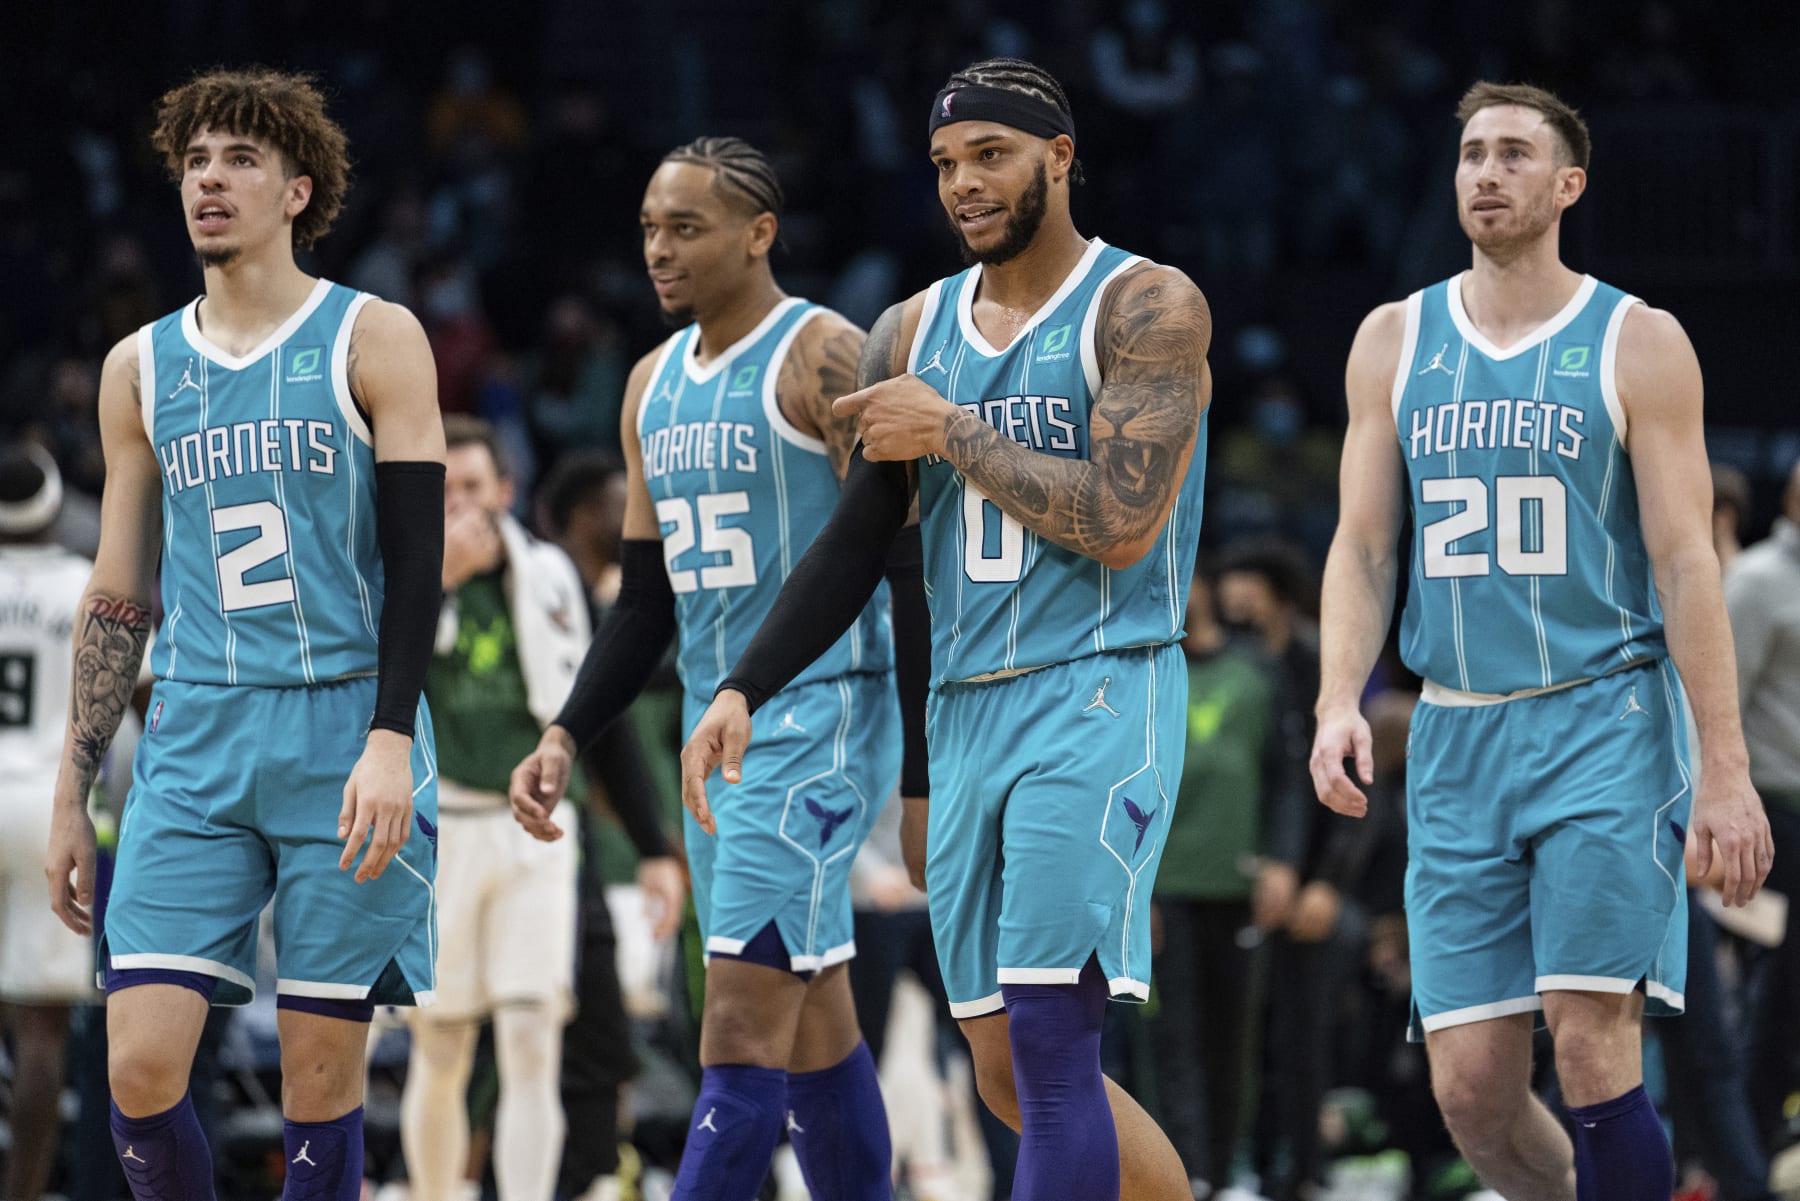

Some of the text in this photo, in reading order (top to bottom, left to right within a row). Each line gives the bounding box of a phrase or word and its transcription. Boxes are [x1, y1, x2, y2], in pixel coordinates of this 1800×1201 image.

[161, 418, 341, 496] HORNETS
[642, 421, 760, 480] HORNETS
[1407, 398, 1588, 461] HORNETS
[211, 500, 297, 612] 2
[656, 491, 758, 593] 25
[963, 474, 1025, 583] 0
[1421, 475, 1568, 578] 20
